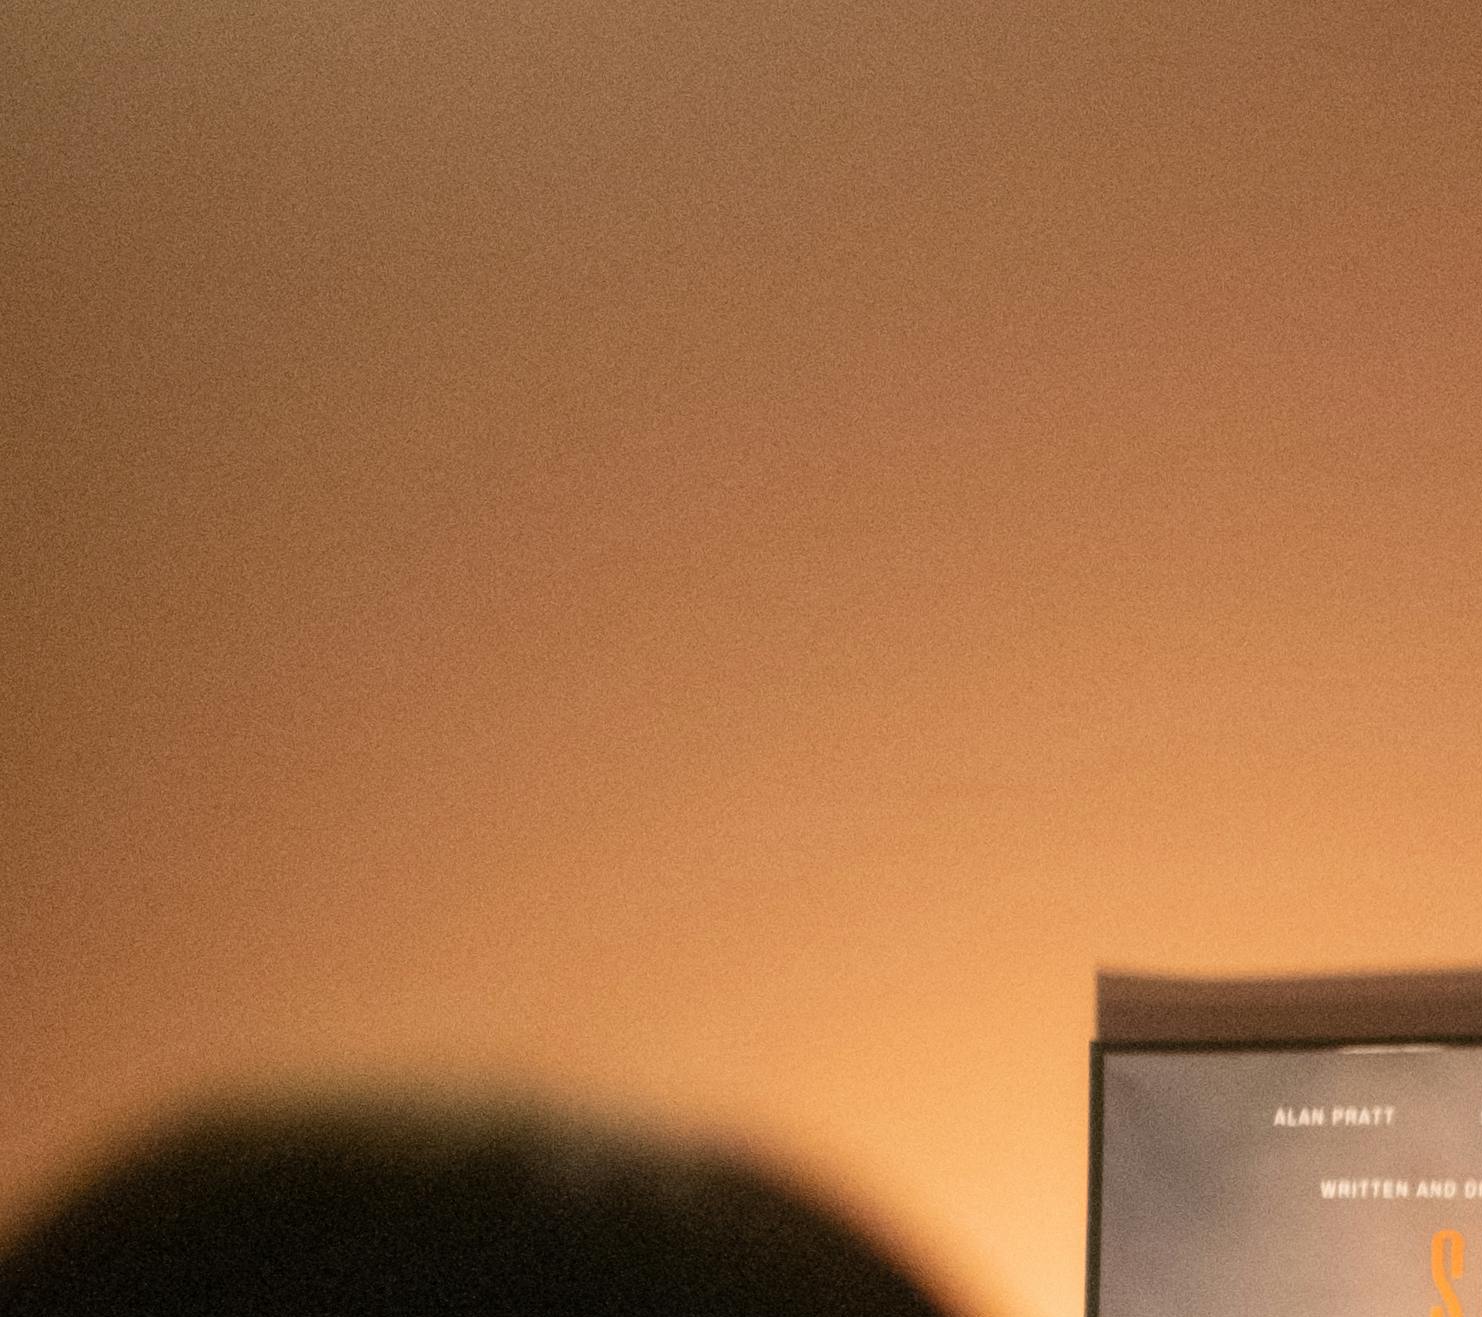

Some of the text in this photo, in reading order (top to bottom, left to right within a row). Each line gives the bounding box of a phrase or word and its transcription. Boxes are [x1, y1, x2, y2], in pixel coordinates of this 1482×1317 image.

[1273, 1105, 1396, 1127] ALAN PRATT
[1320, 1178, 1409, 1200] WRITTEN
[1415, 1178, 1458, 1200] AND
